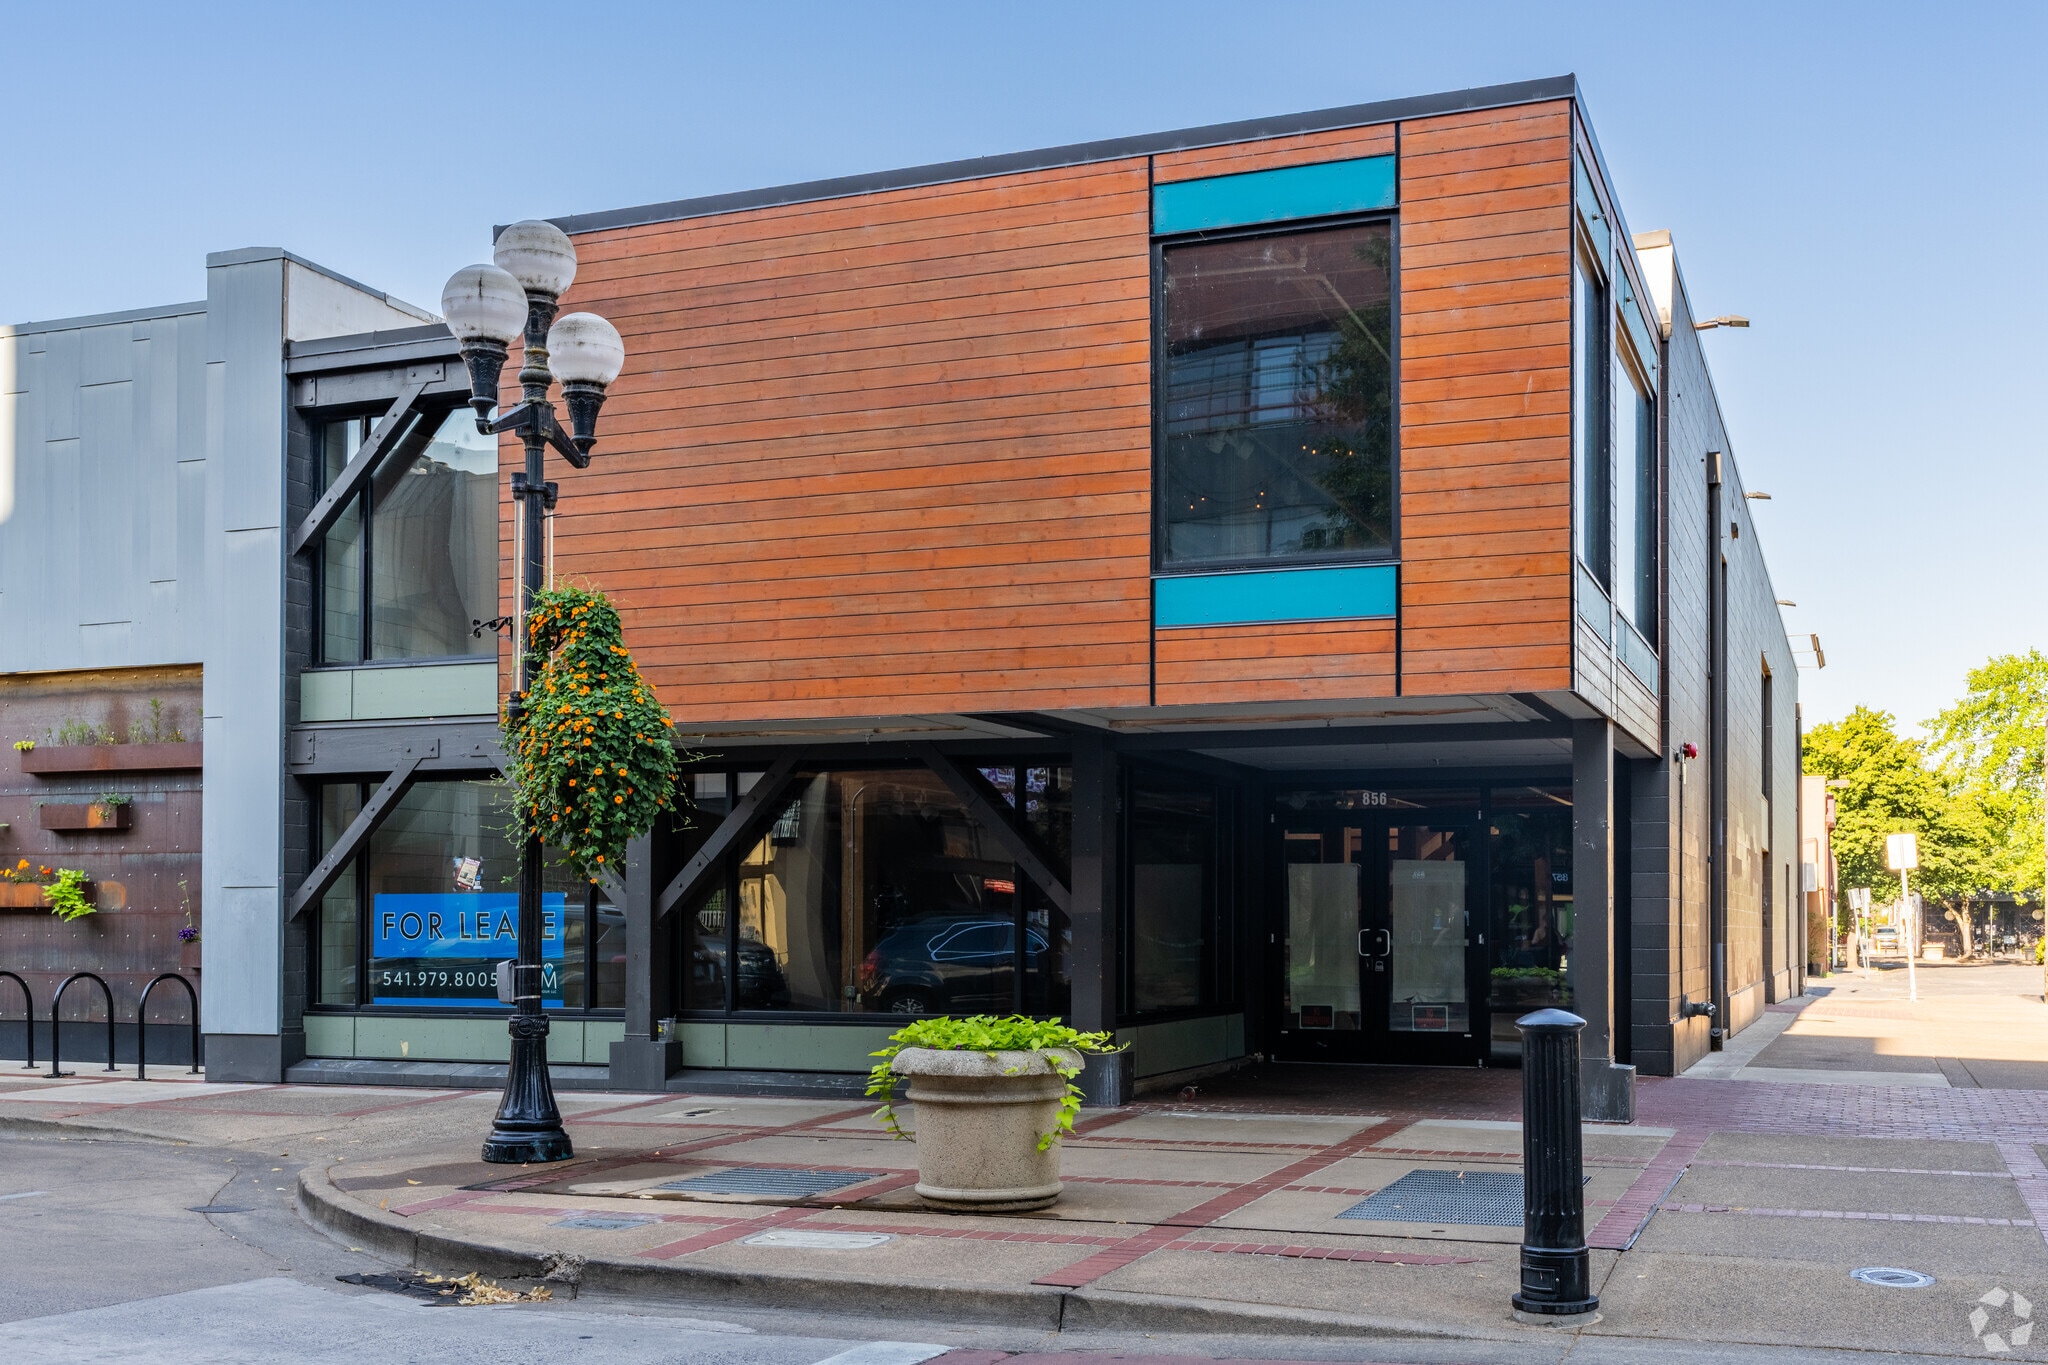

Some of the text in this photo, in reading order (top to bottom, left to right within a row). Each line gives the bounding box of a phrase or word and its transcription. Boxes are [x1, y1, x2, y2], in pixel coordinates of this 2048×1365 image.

[1362, 792, 1387, 806] 856
[382, 910, 556, 941] FOR LEAE
[383, 971, 498, 987] 541.979.8005
